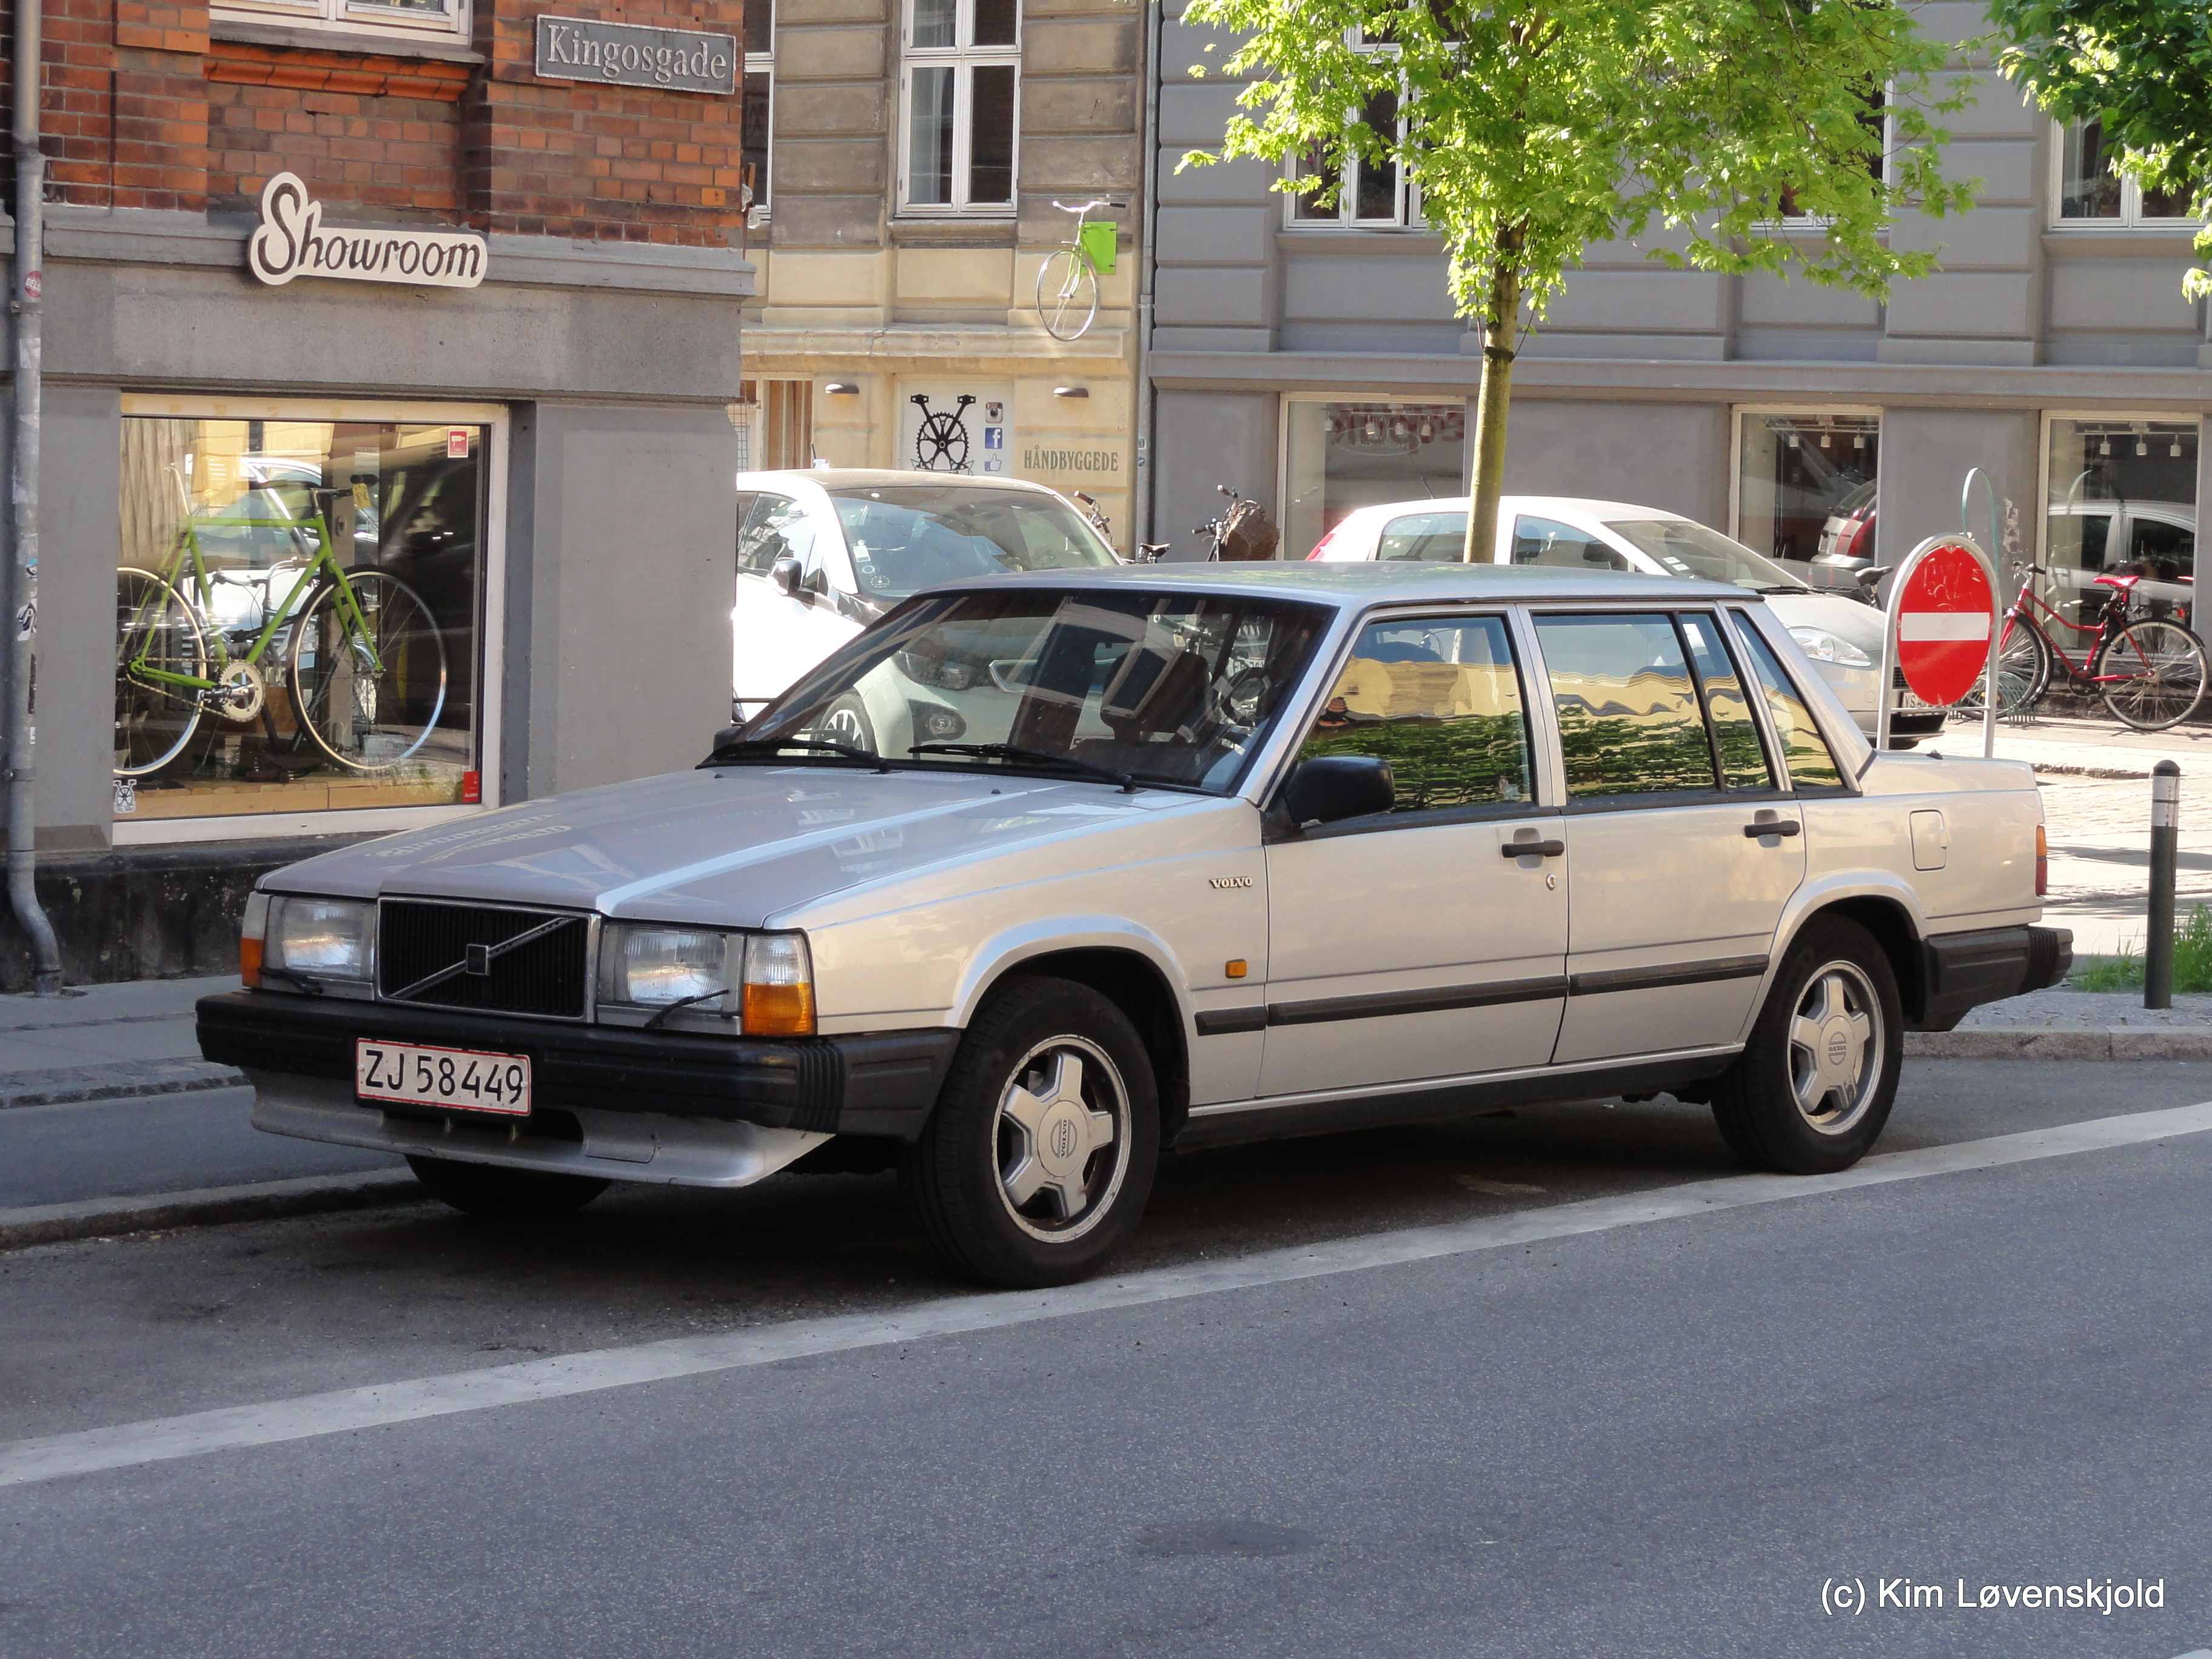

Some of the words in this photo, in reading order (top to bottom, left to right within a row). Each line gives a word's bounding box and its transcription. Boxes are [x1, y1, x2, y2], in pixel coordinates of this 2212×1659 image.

[546, 24, 726, 83] Kingosgade
[257, 183, 481, 278] Showroom
[1024, 444, 1119, 471] HÅNDBYGGEDE
[1208, 877, 1253, 888] VOLVO
[366, 1050, 404, 1090] ZJ
[417, 1055, 523, 1104] 58449
